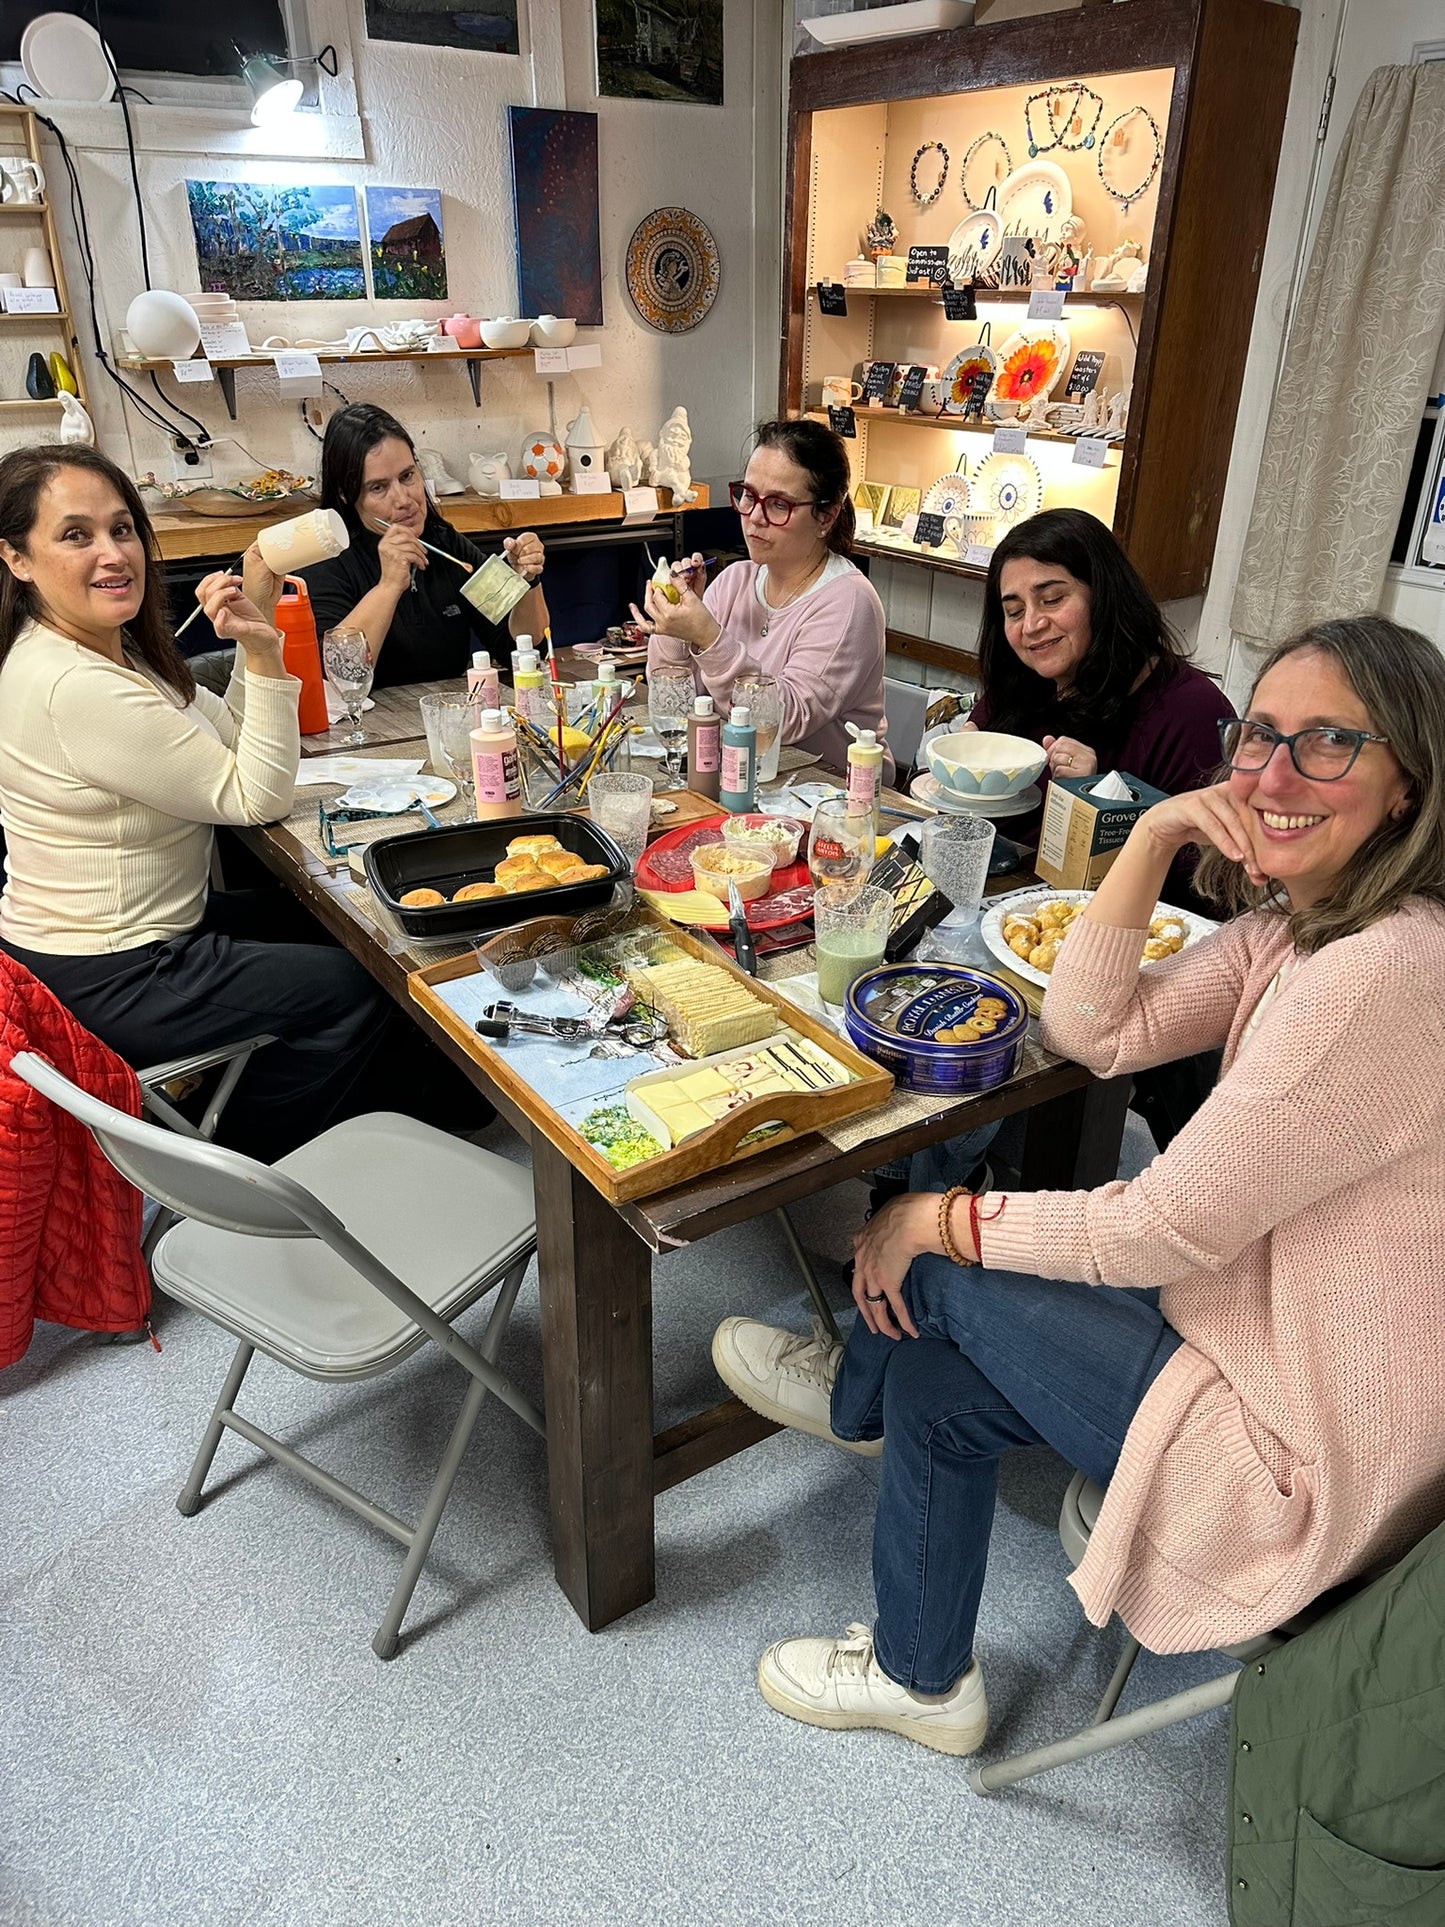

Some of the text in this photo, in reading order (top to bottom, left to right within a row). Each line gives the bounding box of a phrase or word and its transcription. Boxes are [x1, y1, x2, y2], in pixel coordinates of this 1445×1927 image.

[911, 248, 927, 258] Open
[1101, 812, 1136, 824] Grove
[1100, 828, 1131, 838] Tree-Fre
[817, 841, 839, 851] STELLA
[1098, 837, 1124, 845] Tissues
[816, 847, 839, 857] ARTOIS
[902, 981, 969, 1032] ROYAL DANSK
[923, 993, 984, 1036] Danish Butter Cookies
[877, 1045, 908, 1060] Nutrition
